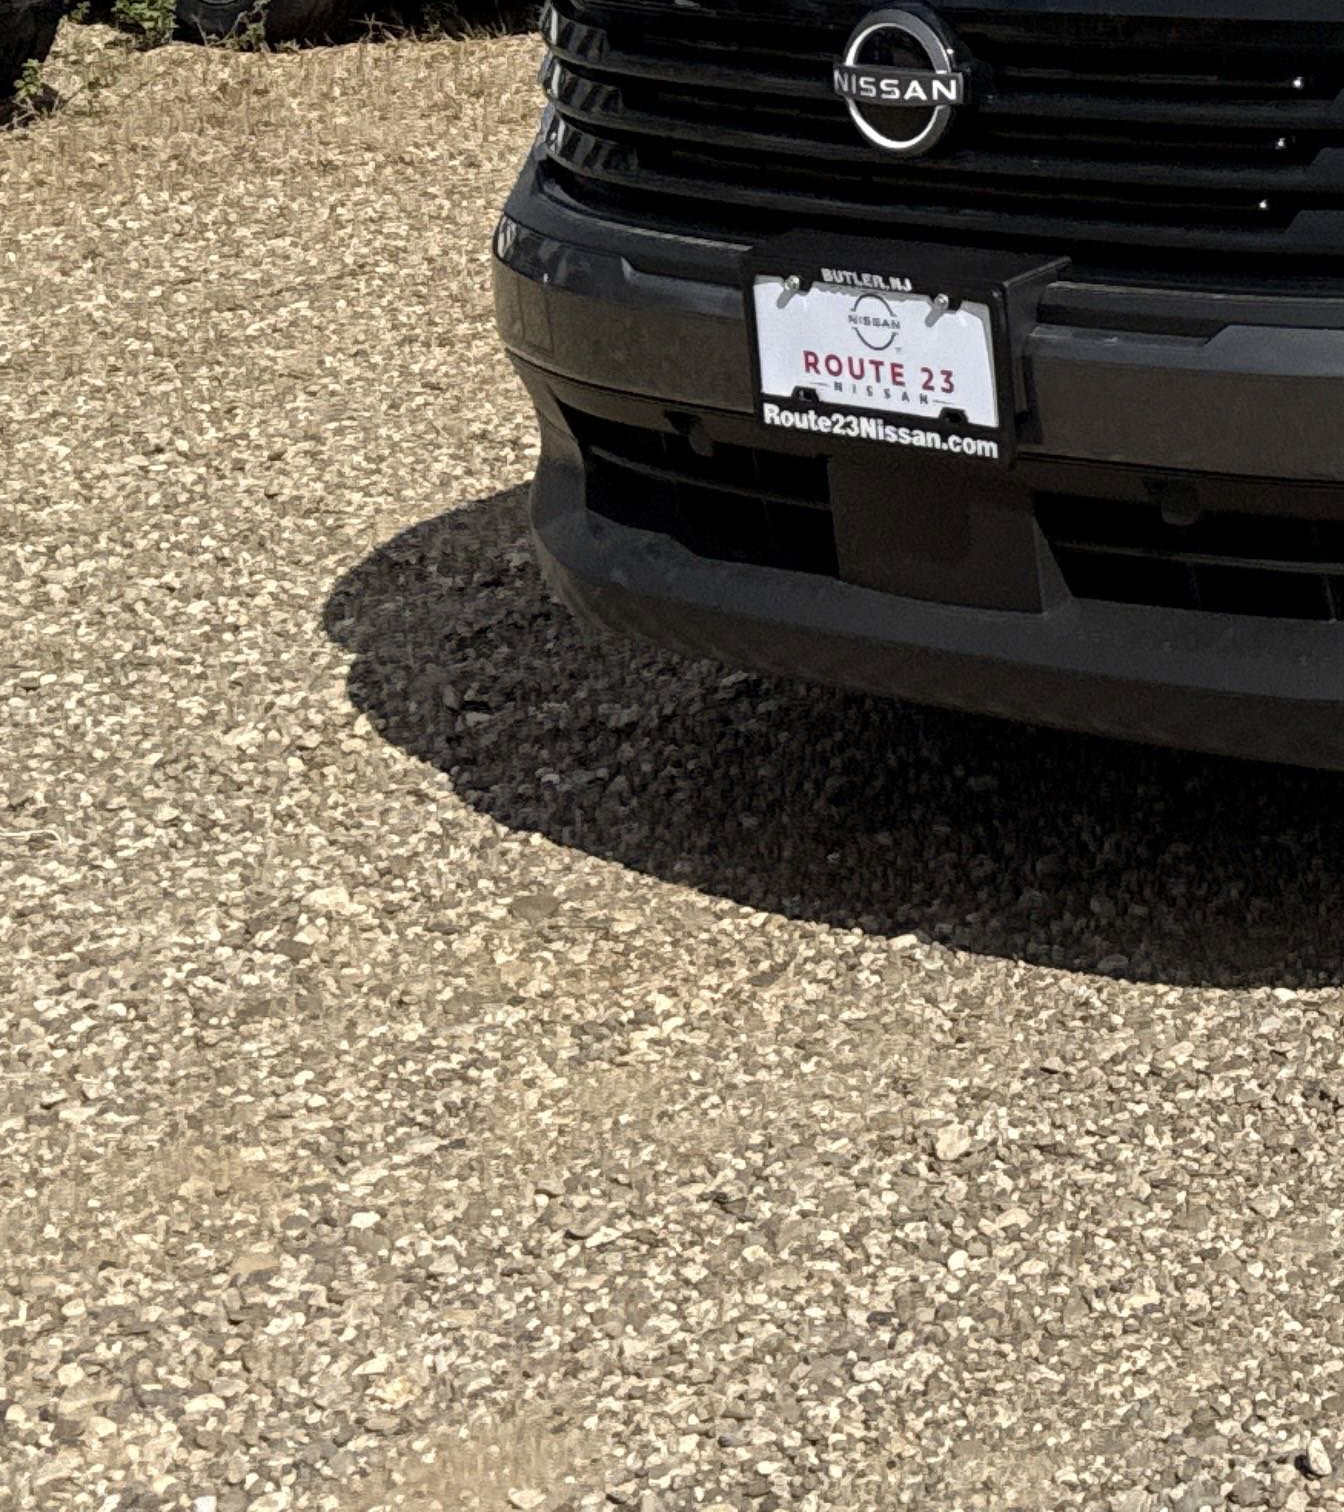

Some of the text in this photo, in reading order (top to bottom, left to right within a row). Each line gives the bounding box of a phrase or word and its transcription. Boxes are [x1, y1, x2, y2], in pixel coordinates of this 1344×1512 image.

[833, 69, 957, 101] NISSAN
[848, 314, 900, 330] NISSAN
[803, 350, 955, 394] ROUTE 23
[833, 381, 929, 405] NISSAN
[762, 402, 999, 459] Route23Nissan.com
